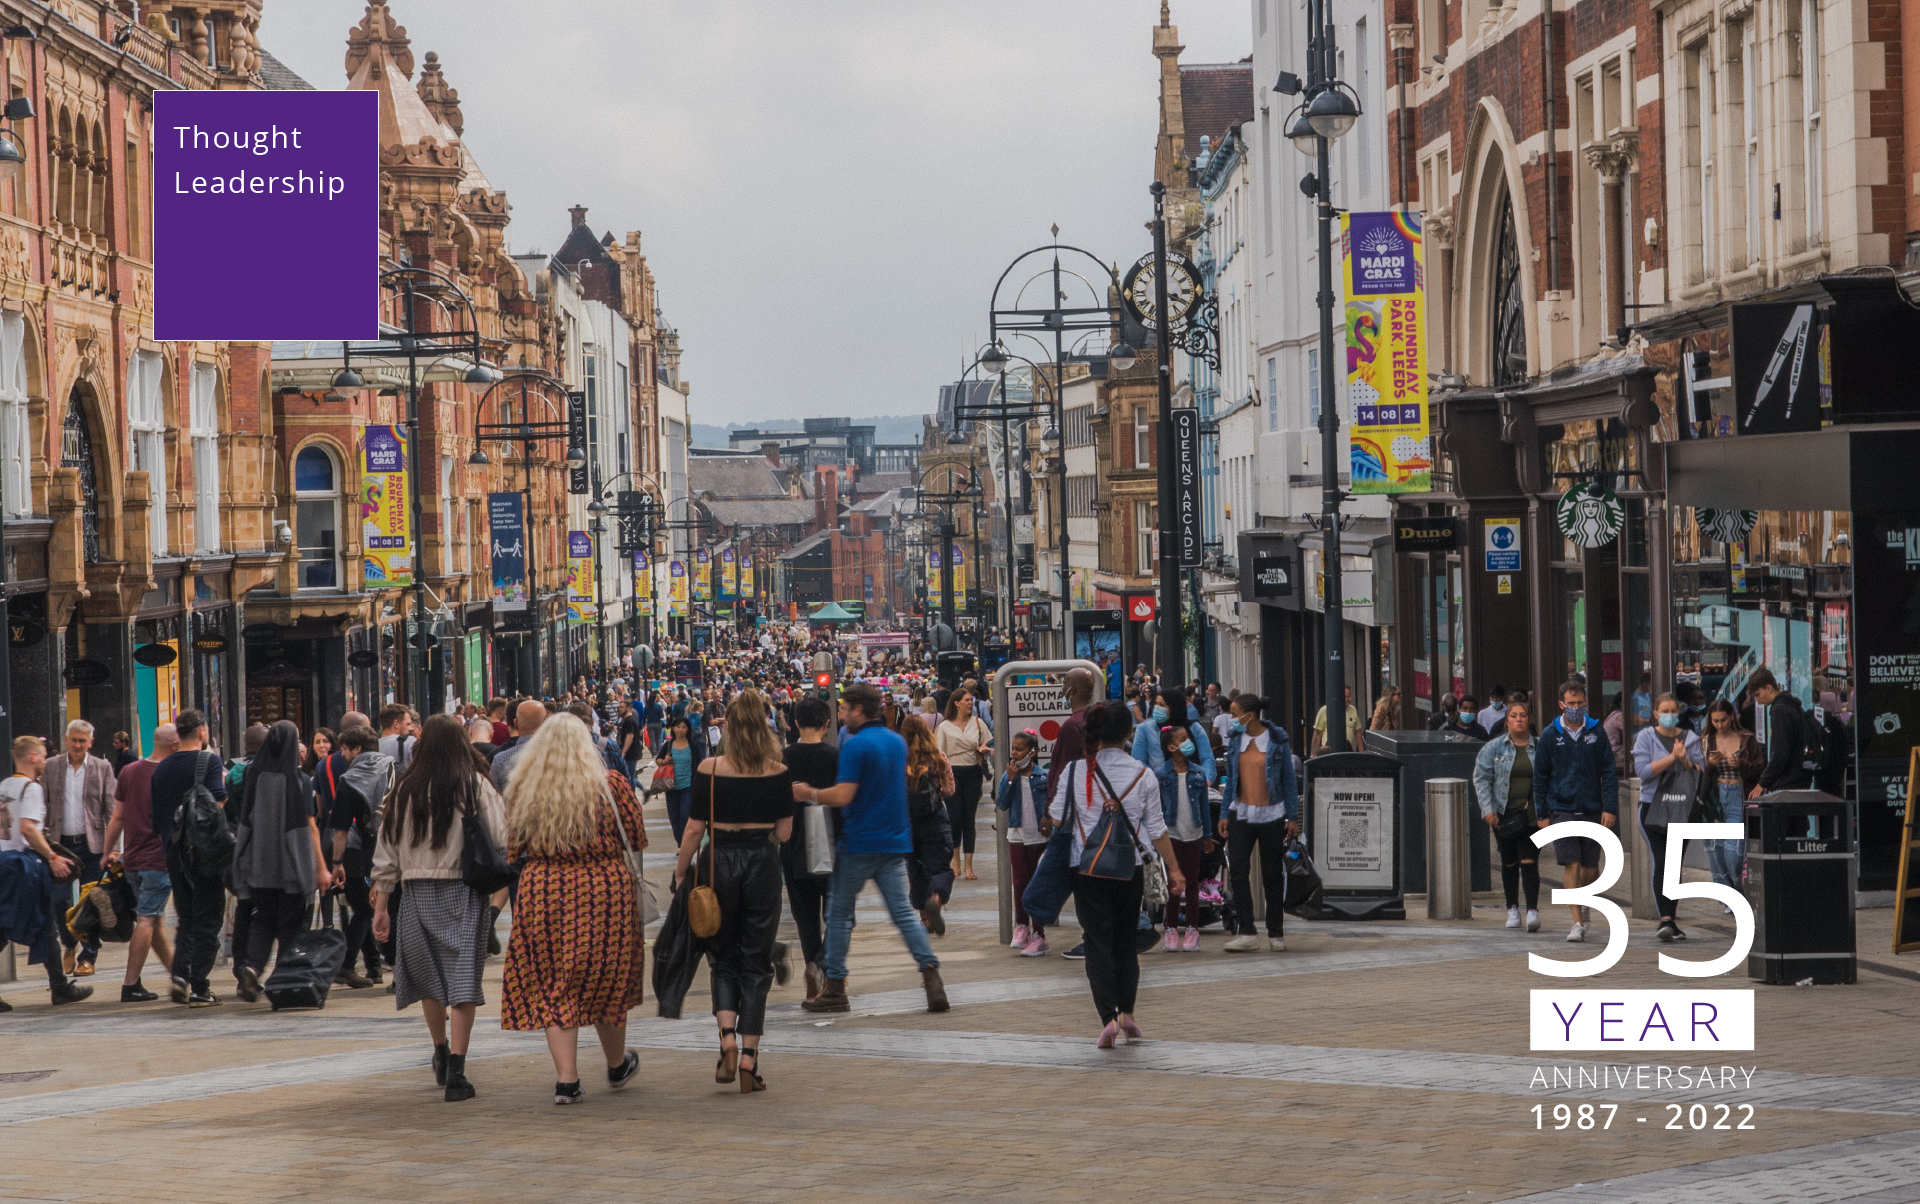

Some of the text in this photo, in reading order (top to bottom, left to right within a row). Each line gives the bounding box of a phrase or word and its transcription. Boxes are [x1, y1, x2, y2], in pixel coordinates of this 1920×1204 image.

[1140, 254, 1185, 266] QUN'S
[1360, 256, 1404, 268] MARDI
[1364, 268, 1402, 279] GRAS
[1404, 300, 1419, 394] ROUNDHAY
[1392, 351, 1406, 398] LEEDS
[1362, 409, 1415, 420] 14 08 21
[1180, 416, 1194, 560] QUEEN'S ARCADE
[396, 476, 404, 532] ROUNDHAY
[1400, 528, 1452, 539] Dune
[1887, 531, 1903, 541] the
[1870, 655, 1906, 666] DON'T
[1870, 666, 1915, 676] BELIEVE
[1334, 793, 1375, 801] NOW OPEN!
[1797, 841, 1827, 852] Litter
